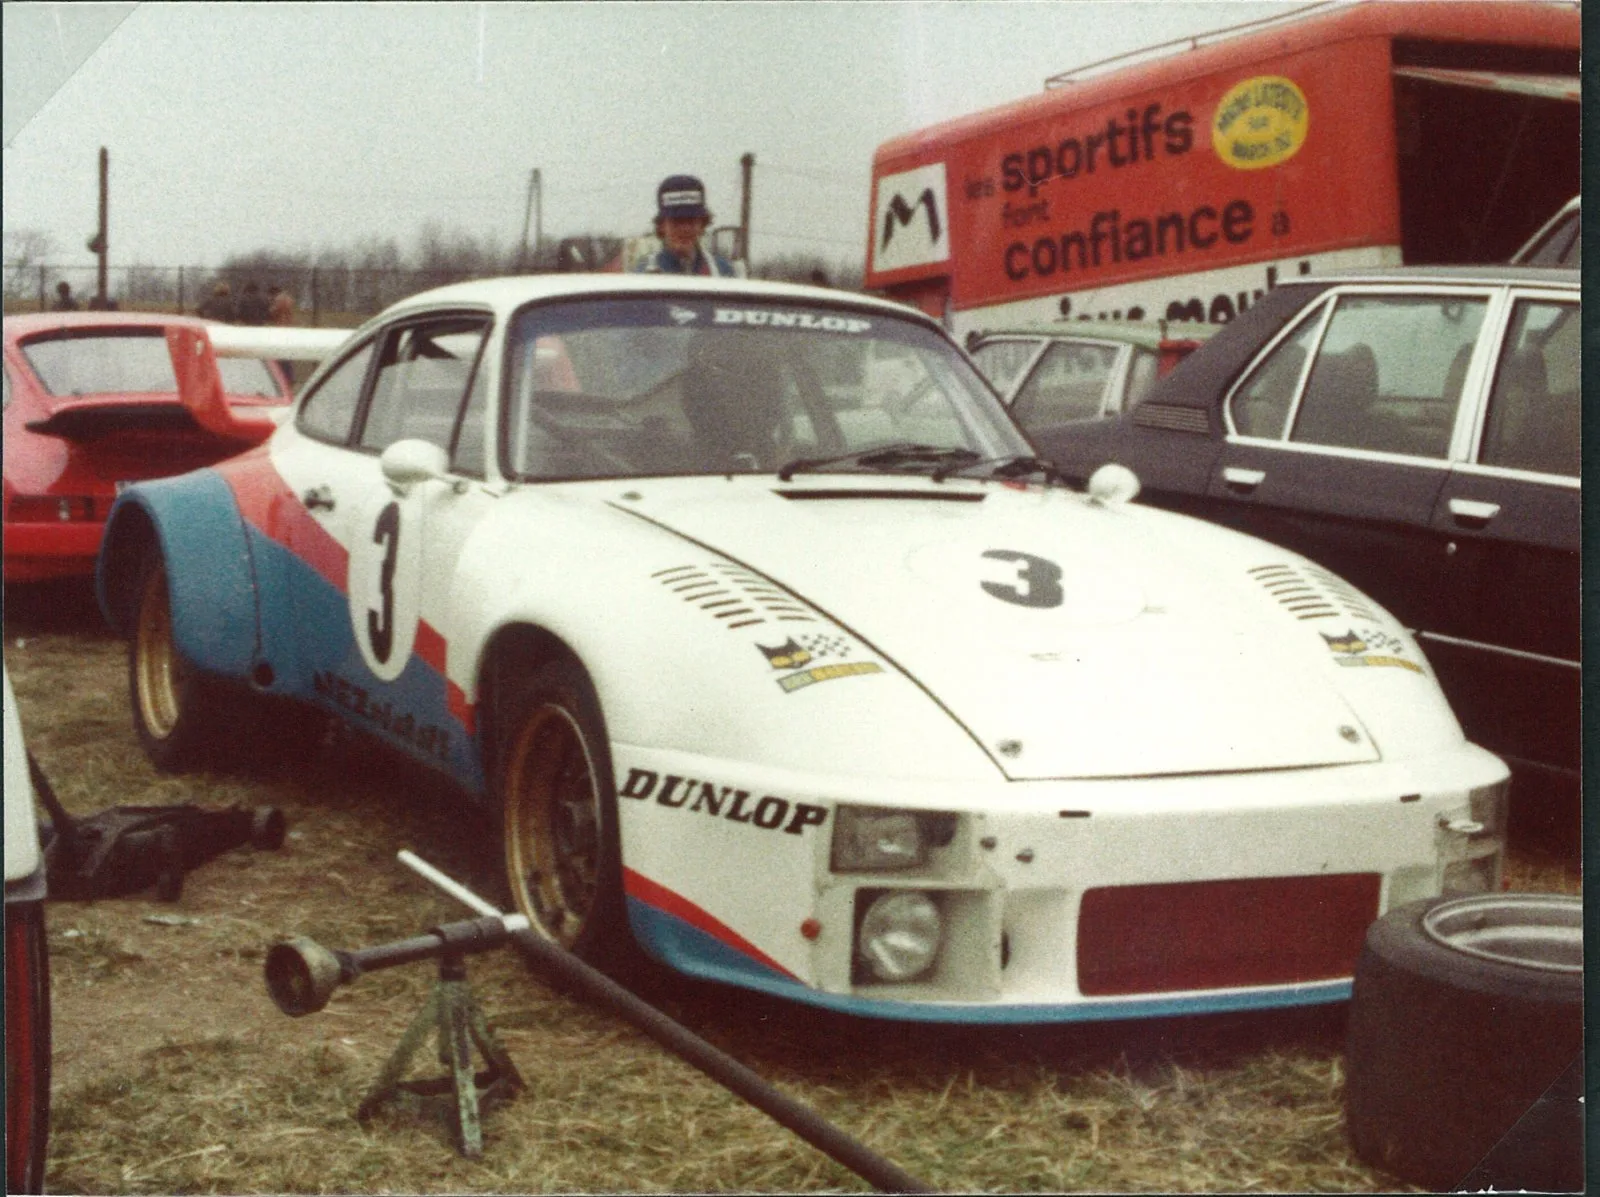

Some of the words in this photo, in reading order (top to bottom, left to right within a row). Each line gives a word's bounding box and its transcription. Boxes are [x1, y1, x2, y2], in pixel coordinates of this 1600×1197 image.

[1001, 105, 1194, 196] sportifs
[1004, 198, 1254, 281] confiance
[713, 308, 871, 333] DUNLOP
[367, 501, 400, 665] 3
[980, 549, 1064, 609] 3
[618, 767, 829, 835] DUNLOP
